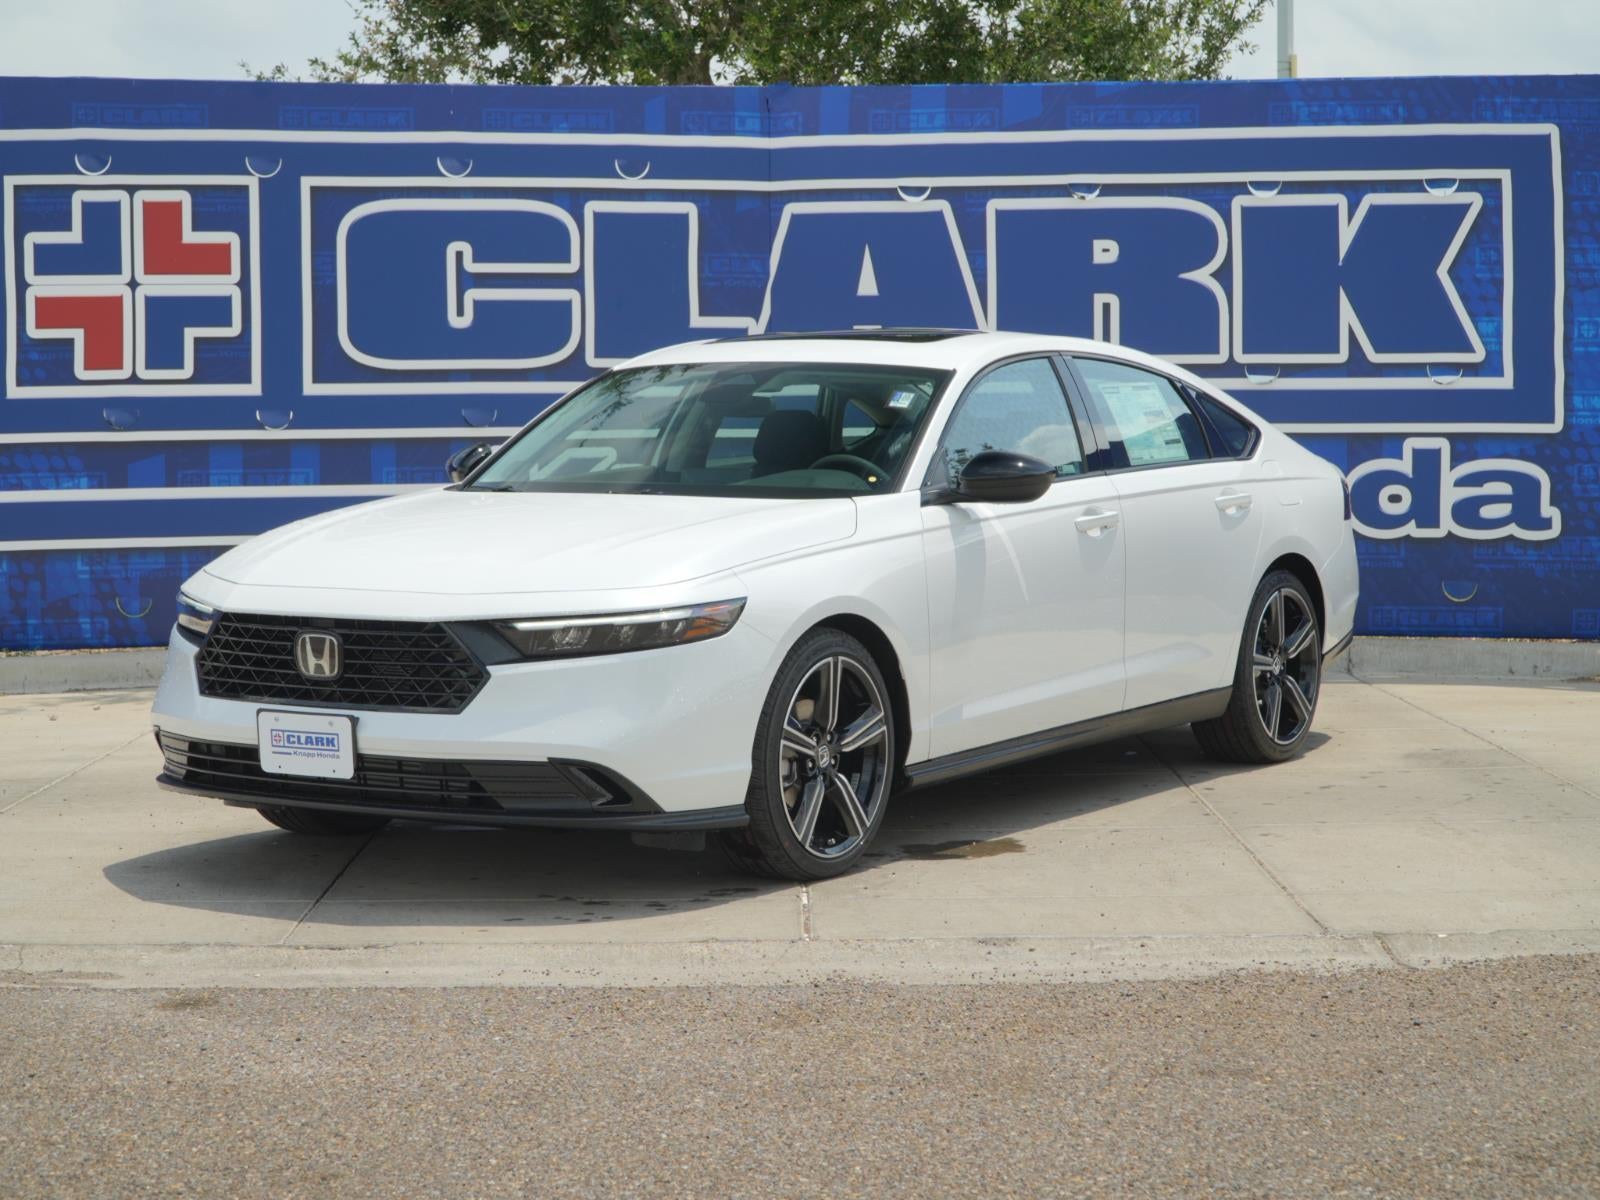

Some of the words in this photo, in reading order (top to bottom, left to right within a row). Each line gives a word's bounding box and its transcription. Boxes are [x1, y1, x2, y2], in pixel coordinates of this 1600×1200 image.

[336, 192, 1484, 370] CLARK
[286, 734, 336, 748] CLARK
[293, 750, 316, 759] Knapp
[317, 751, 340, 760] Honda
